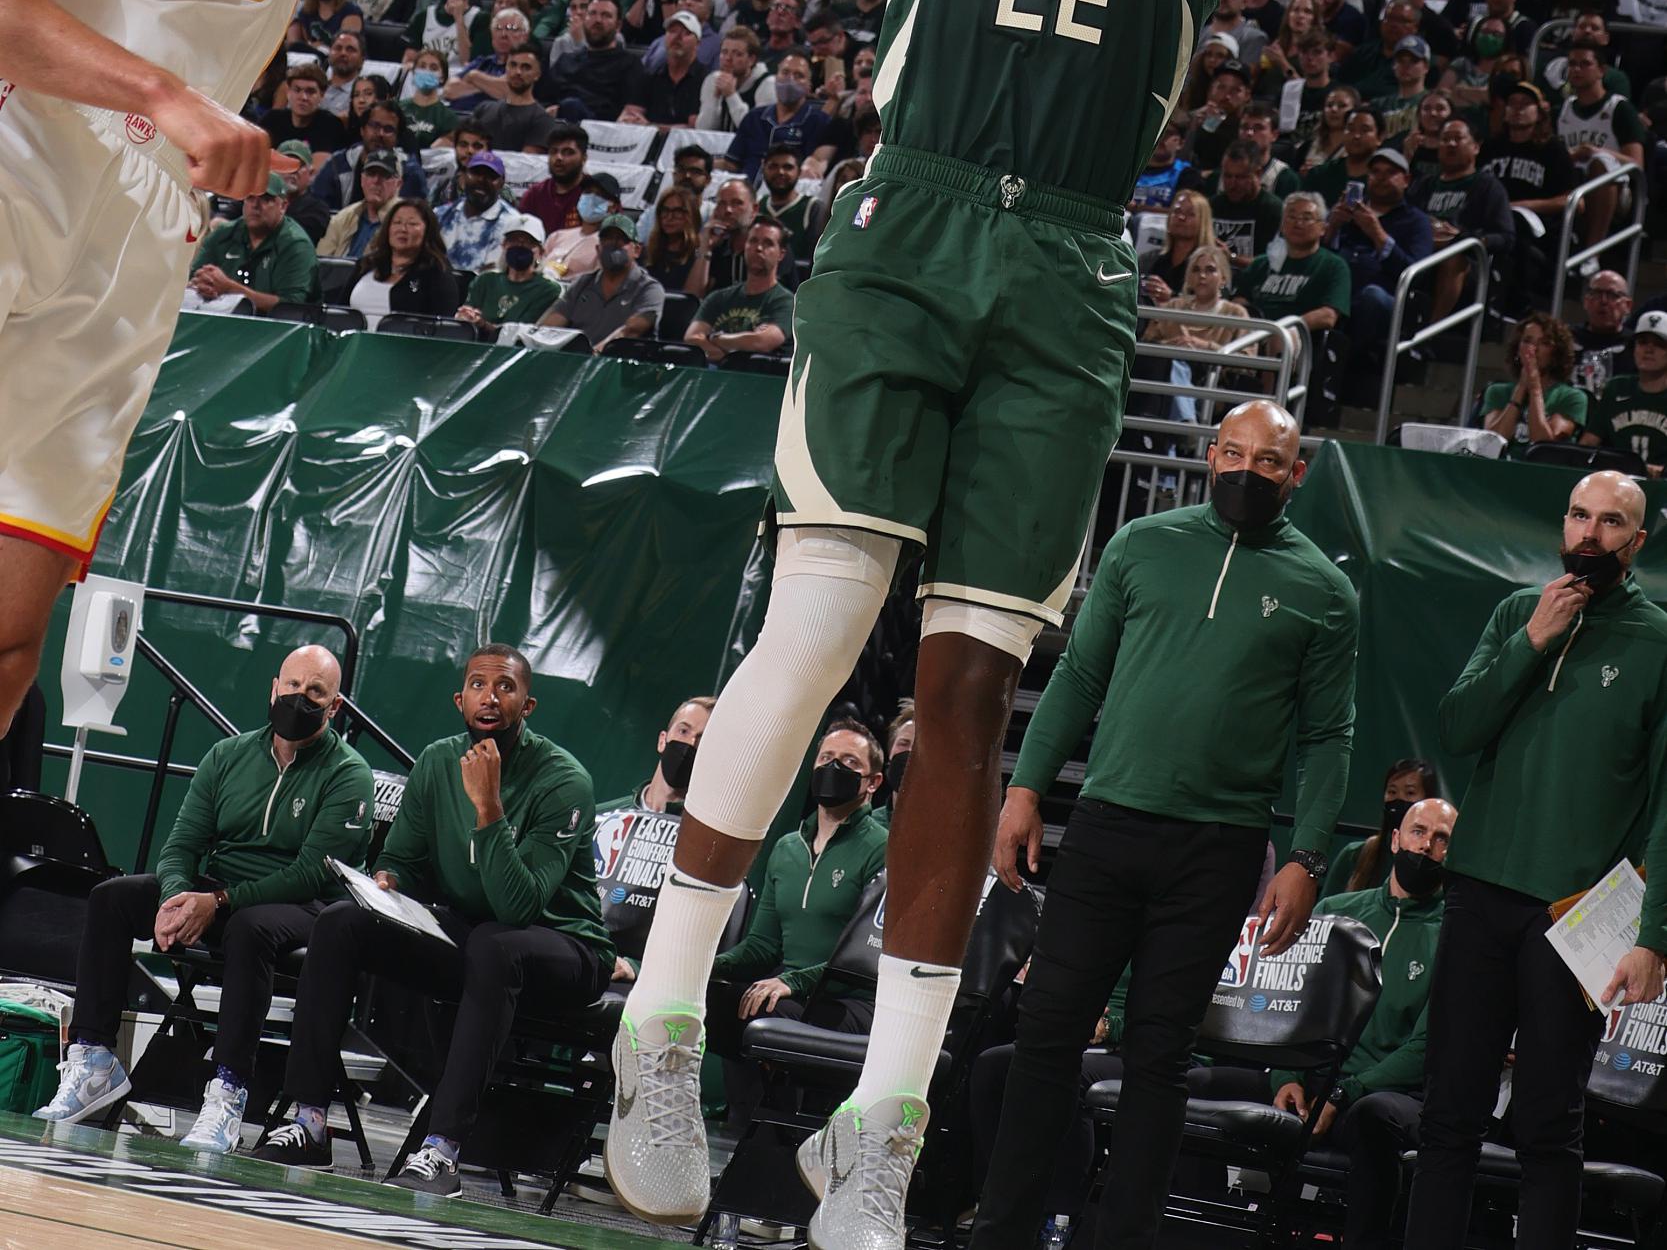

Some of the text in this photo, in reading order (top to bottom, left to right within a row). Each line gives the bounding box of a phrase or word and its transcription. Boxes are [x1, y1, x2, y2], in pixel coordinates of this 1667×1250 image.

[124, 112, 157, 141] HAWKS
[1566, 130, 1608, 147] UCKS
[634, 815, 680, 846] EASTE
[616, 856, 667, 890] FINALS
[625, 893, 656, 908] AT&T
[1221, 967, 1234, 981] BA
[1252, 961, 1308, 992] FINALS
[1268, 999, 1301, 1012] AT&T
[1631, 1060, 1665, 1077] AT&T
